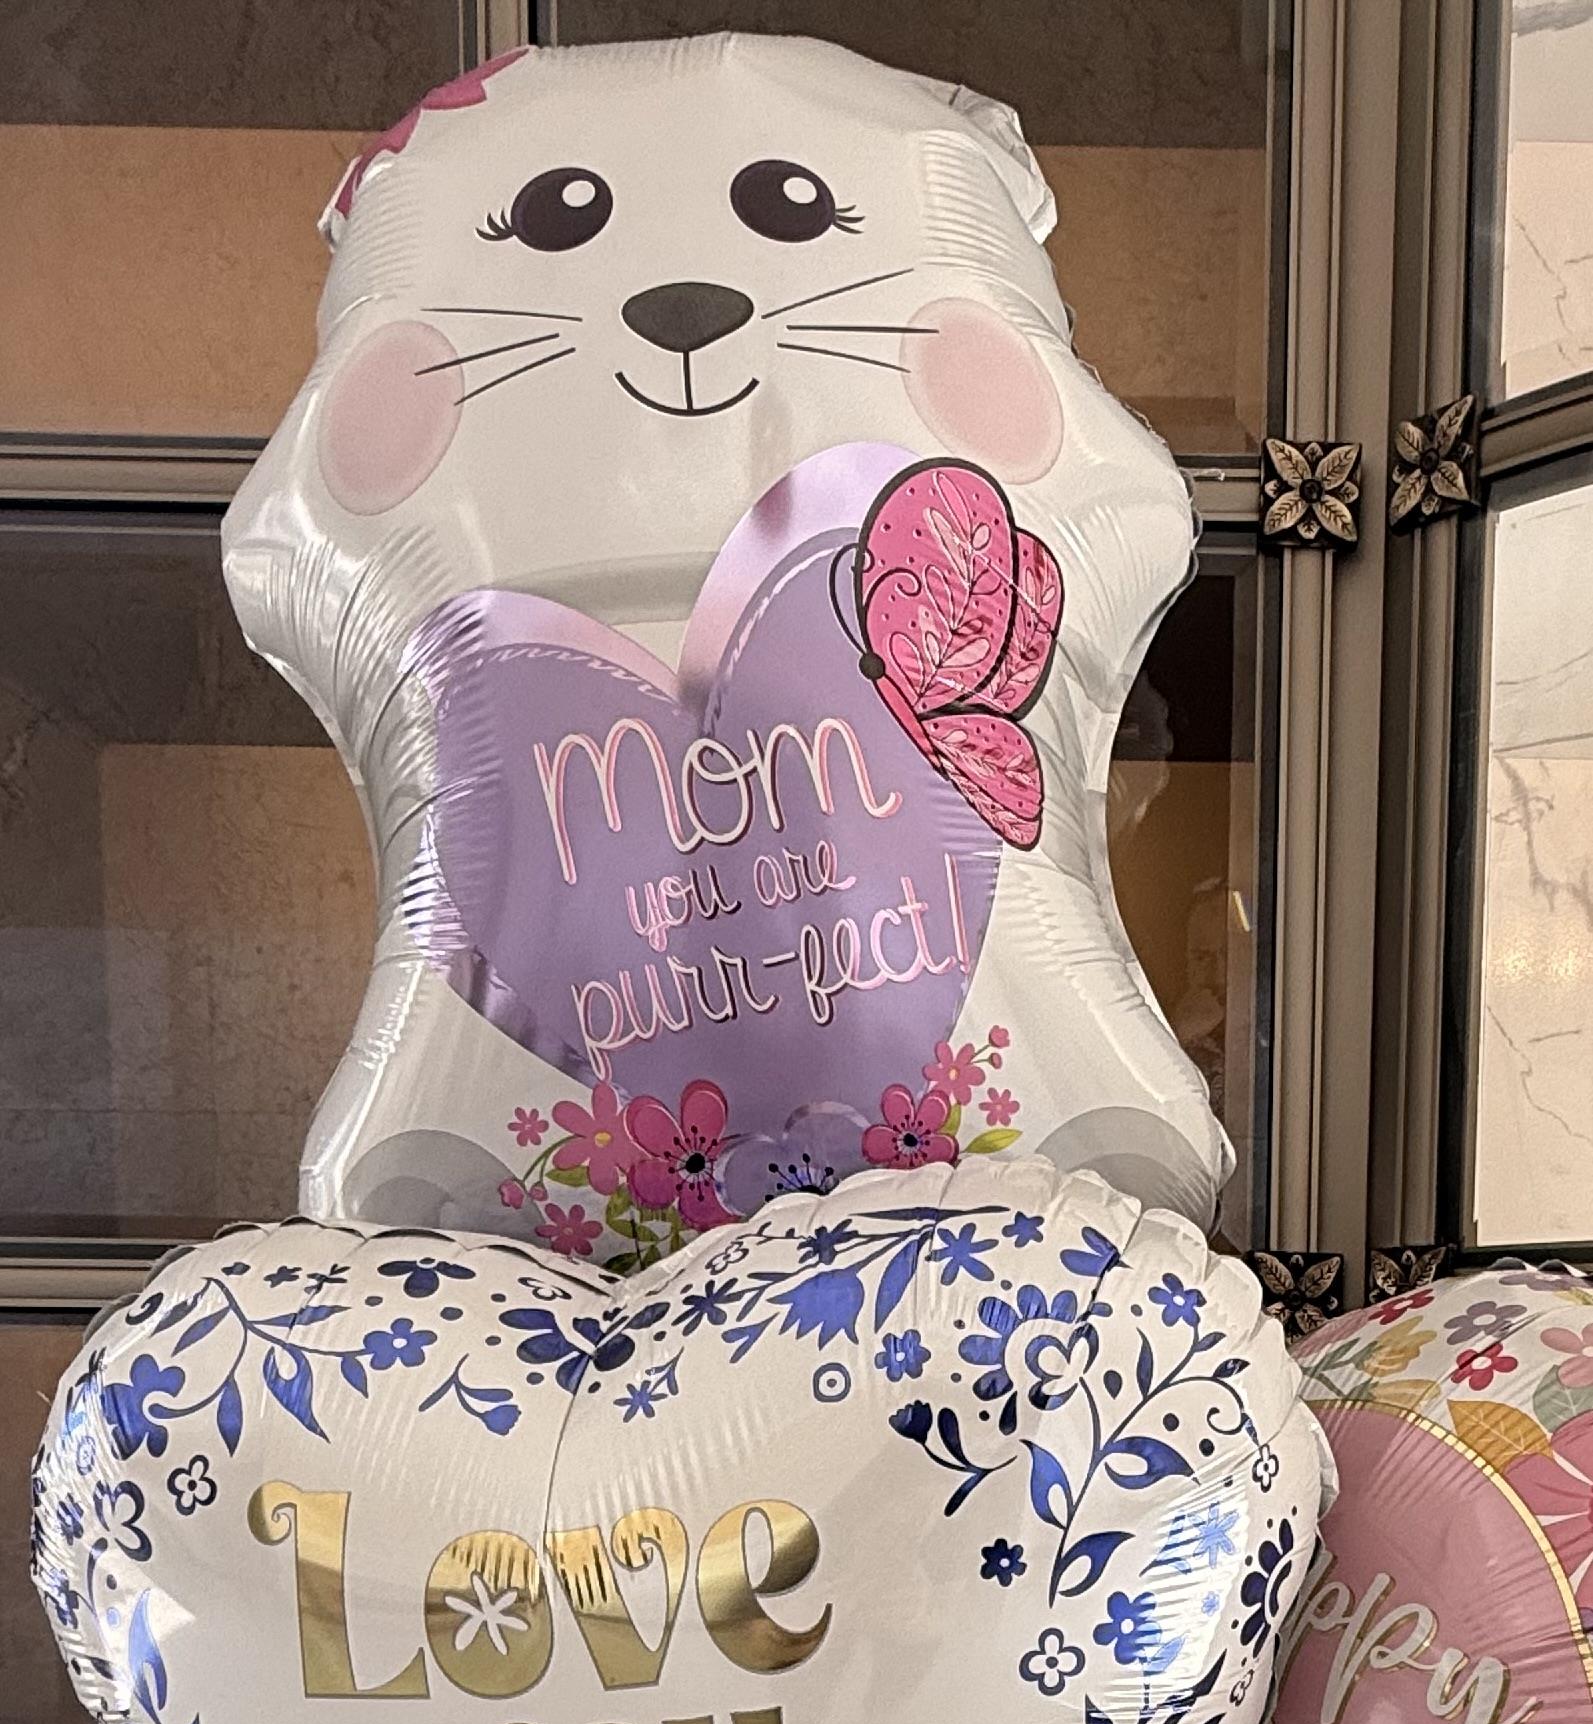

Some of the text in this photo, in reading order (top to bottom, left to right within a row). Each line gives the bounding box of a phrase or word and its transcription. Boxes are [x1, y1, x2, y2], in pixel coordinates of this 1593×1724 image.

[533, 718, 902, 884] Mom
[626, 839, 857, 951] you are
[571, 853, 969, 1082] purr-fect!
[247, 1480, 832, 1700] Love
